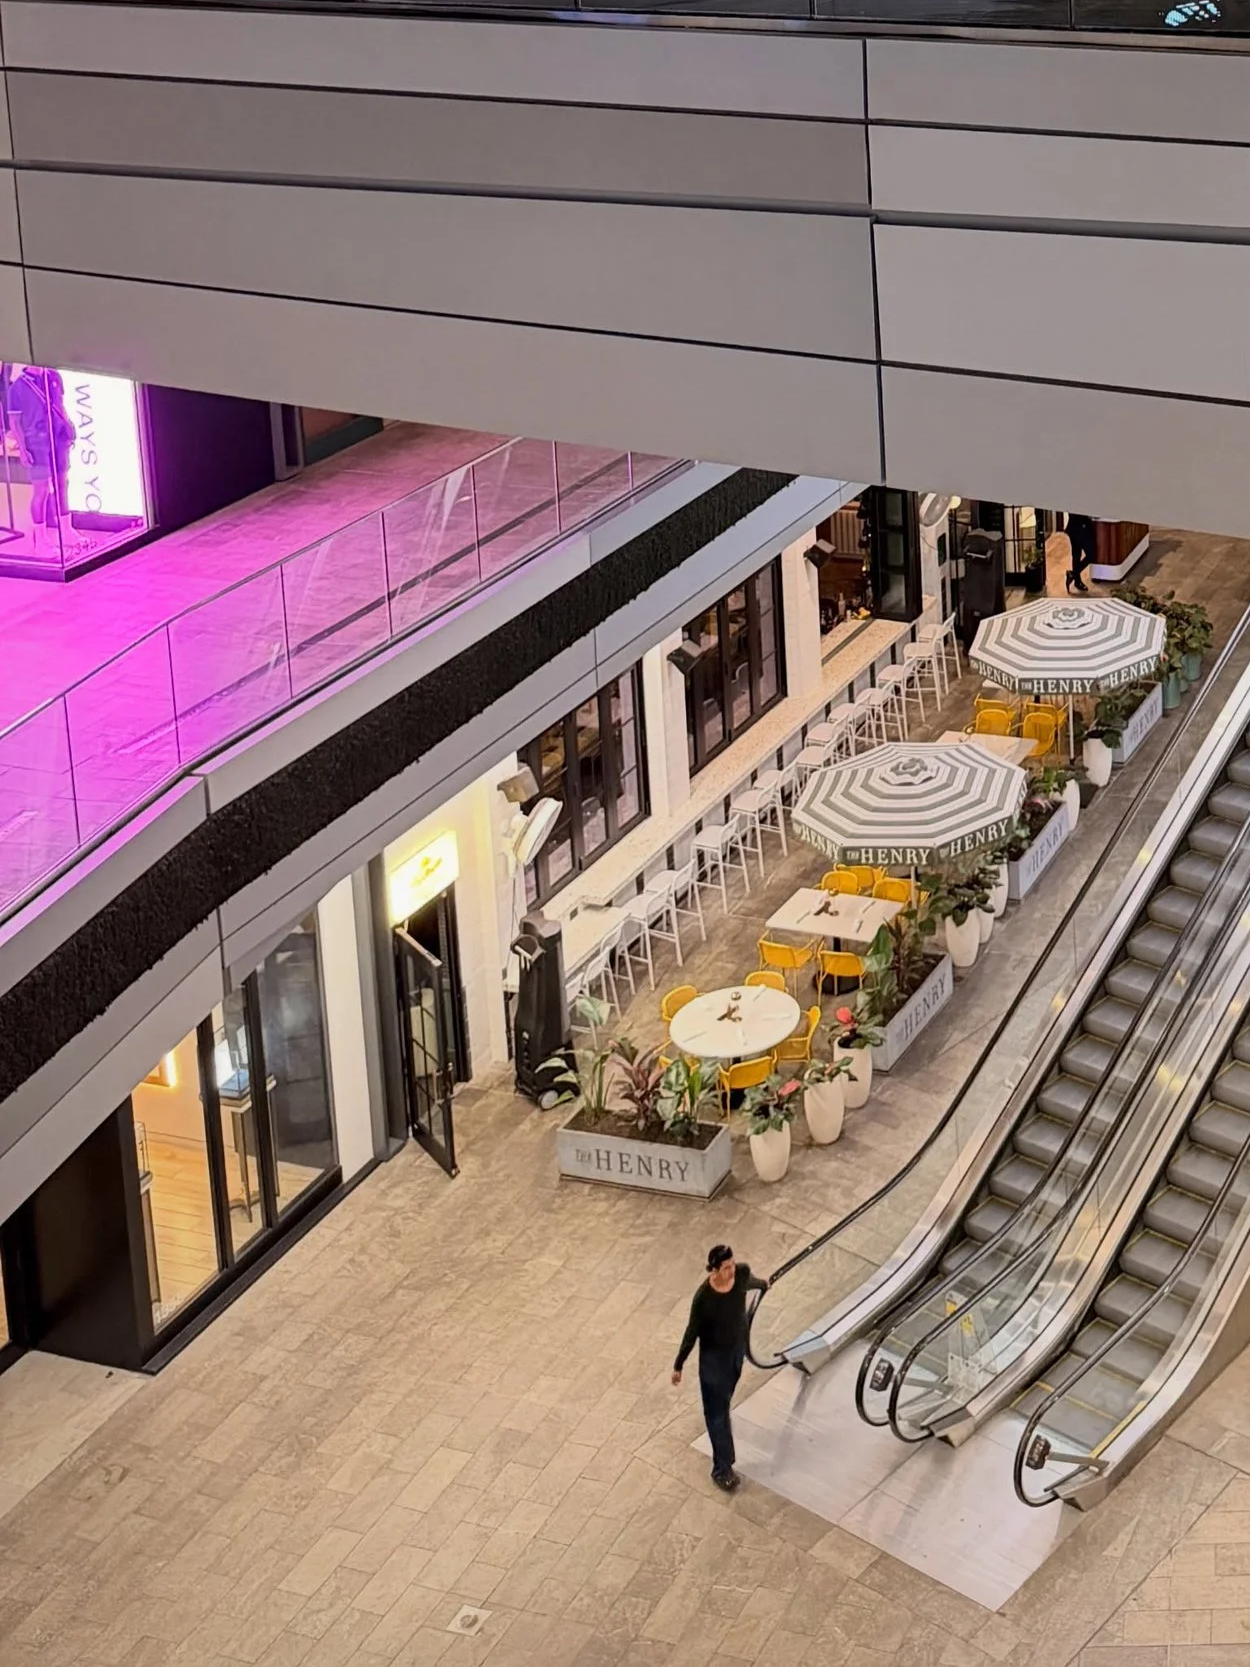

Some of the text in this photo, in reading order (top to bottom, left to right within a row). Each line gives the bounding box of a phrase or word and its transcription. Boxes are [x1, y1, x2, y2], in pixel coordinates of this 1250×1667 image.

[978, 661, 1015, 691] HENRY
[1032, 679, 1094, 694] HENRY
[1109, 656, 1158, 689] HENRY
[950, 819, 1009, 857] HENRY
[860, 847, 931, 865] HENRY
[903, 972, 946, 1041] HENRY
[594, 1148, 690, 1183] HENRY
